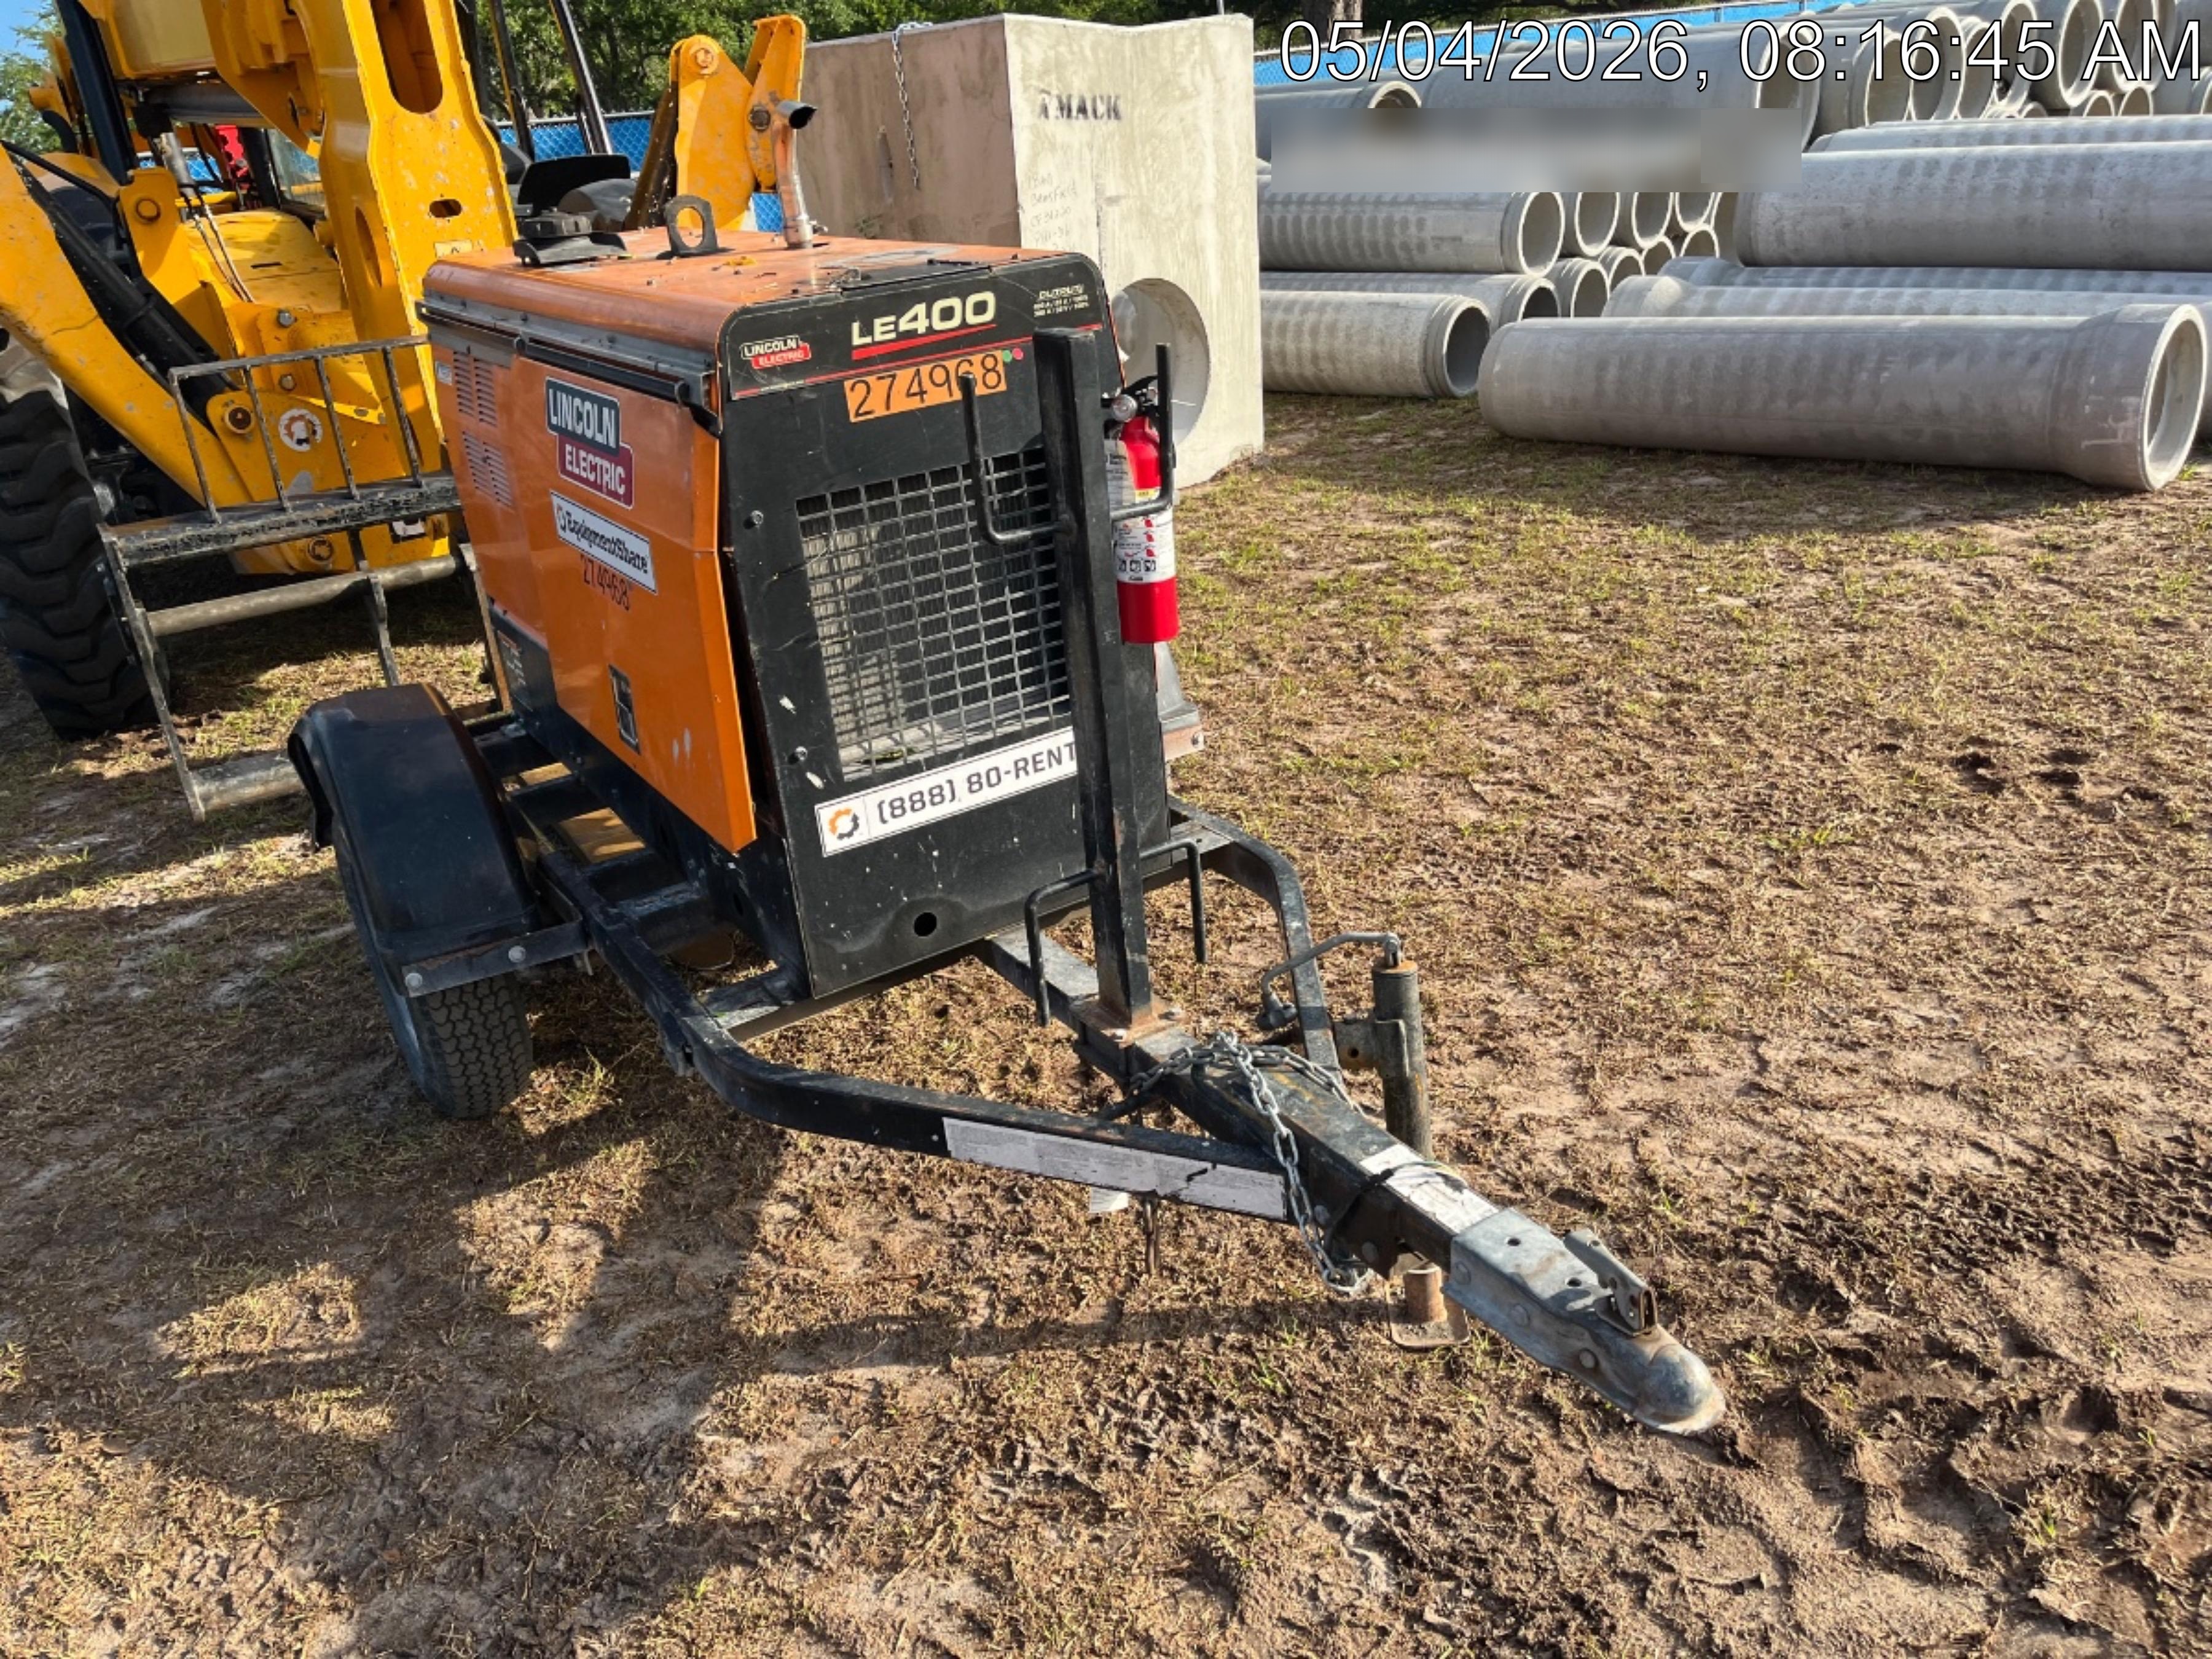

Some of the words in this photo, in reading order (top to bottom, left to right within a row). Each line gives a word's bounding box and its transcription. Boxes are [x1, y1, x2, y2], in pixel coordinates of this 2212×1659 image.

[743, 338, 797, 356] LINCOLN
[850, 291, 996, 347] LE400
[850, 352, 1004, 420] 274968
[548, 388, 617, 447] LINCOLN
[565, 443, 626, 495] ELECTRIC
[877, 779, 957, 825] (888)
[967, 741, 1077, 794] 80-RENT
